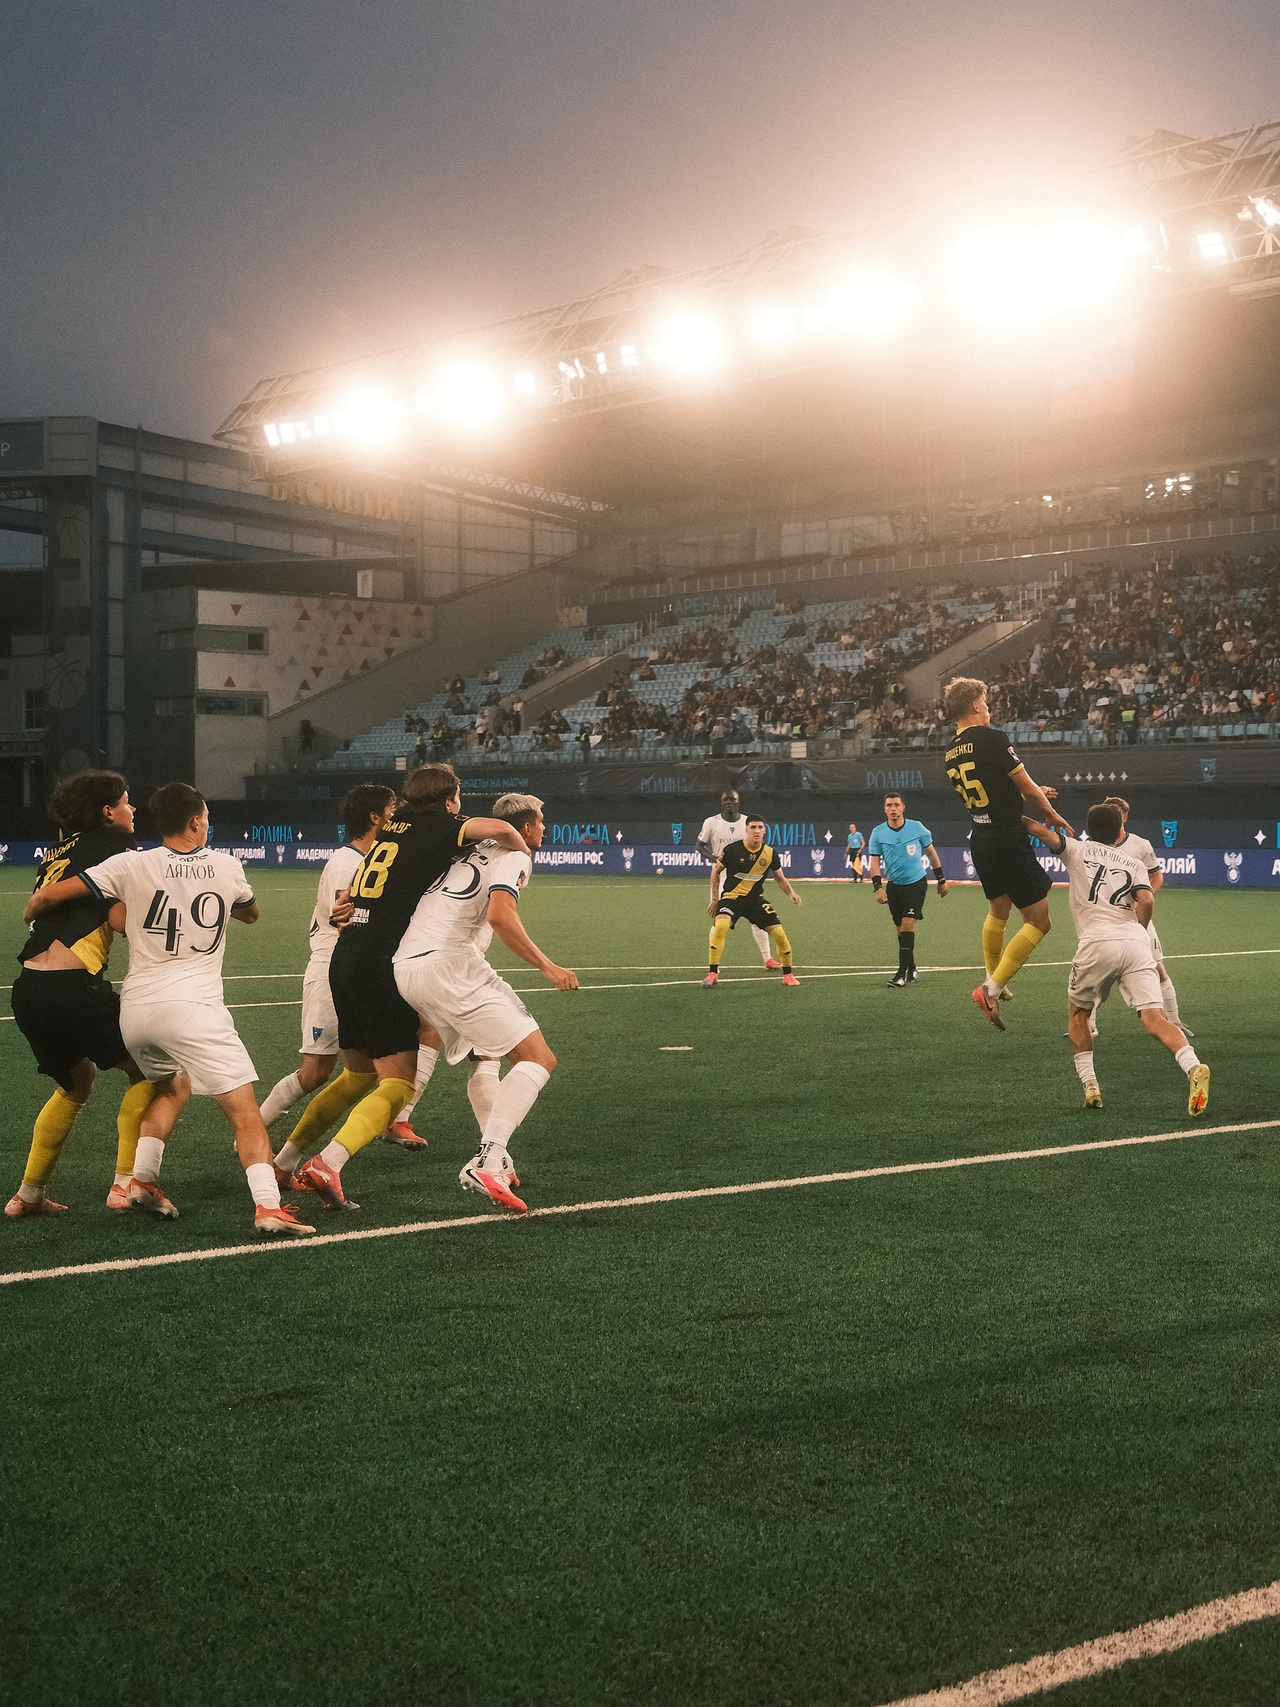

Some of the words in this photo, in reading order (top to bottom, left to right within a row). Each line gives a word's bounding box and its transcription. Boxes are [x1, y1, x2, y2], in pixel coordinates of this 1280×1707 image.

[165, 863, 215, 879] ДЯТЛОВ
[534, 851, 583, 866] АКАДЕМИЯ
[584, 851, 604, 866] РФС
[1084, 859, 1134, 911] 72
[142, 889, 228, 957] 49
